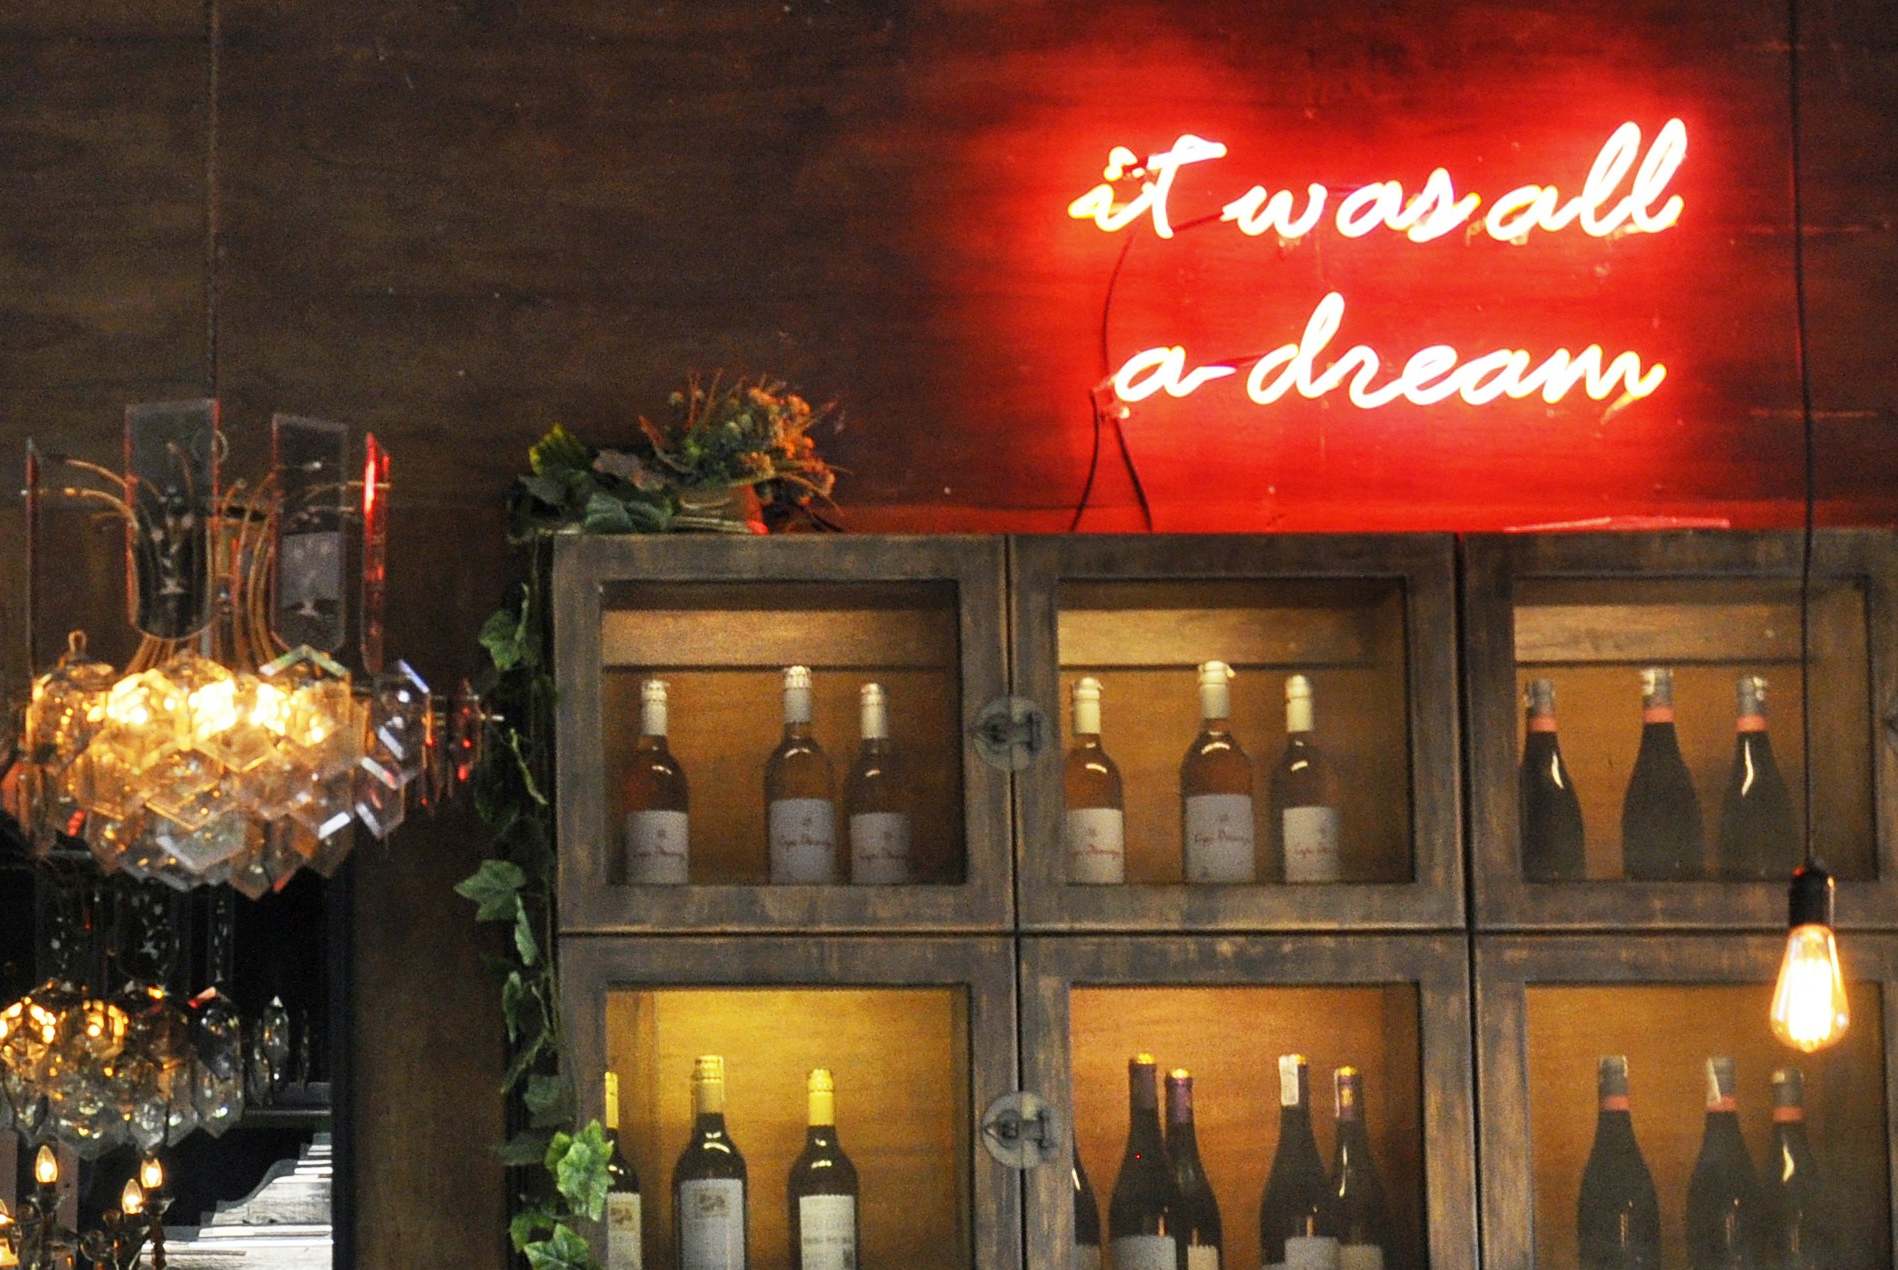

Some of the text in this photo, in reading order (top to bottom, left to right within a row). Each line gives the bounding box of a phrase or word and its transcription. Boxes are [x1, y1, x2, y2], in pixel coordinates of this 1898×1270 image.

[1068, 118, 1688, 243] it was all
[1113, 292, 1667, 410] a dream
